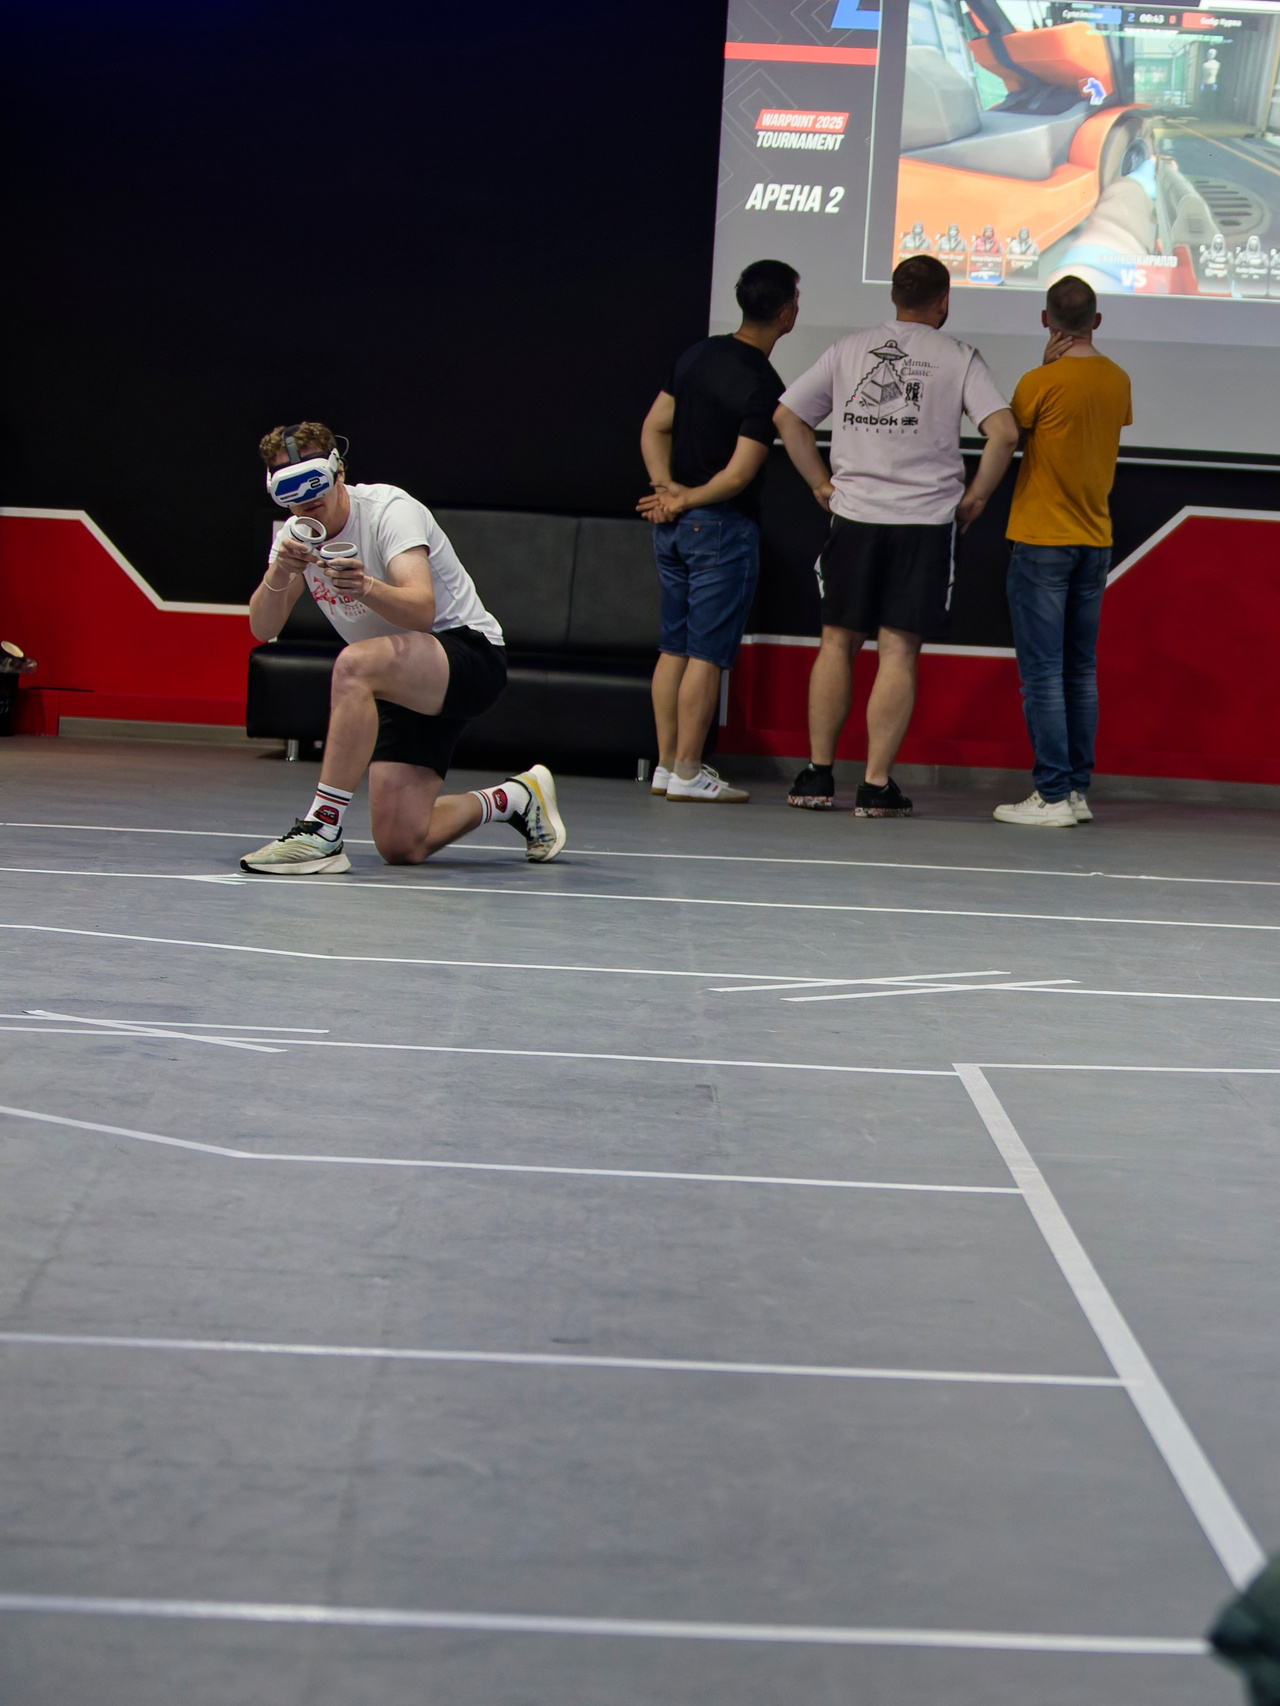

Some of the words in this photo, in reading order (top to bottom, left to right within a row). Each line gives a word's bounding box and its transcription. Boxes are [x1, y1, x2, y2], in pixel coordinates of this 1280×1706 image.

[1128, 12, 1136, 22] 2
[762, 113, 815, 128] WARPOINT
[816, 116, 844, 129] 2025
[756, 131, 845, 151] TOURNAMENT
[745, 182, 823, 213] АРЕНА
[825, 186, 845, 214] 2
[1121, 268, 1147, 288] VS
[843, 412, 898, 426] Reebok
[308, 477, 322, 489] 2
